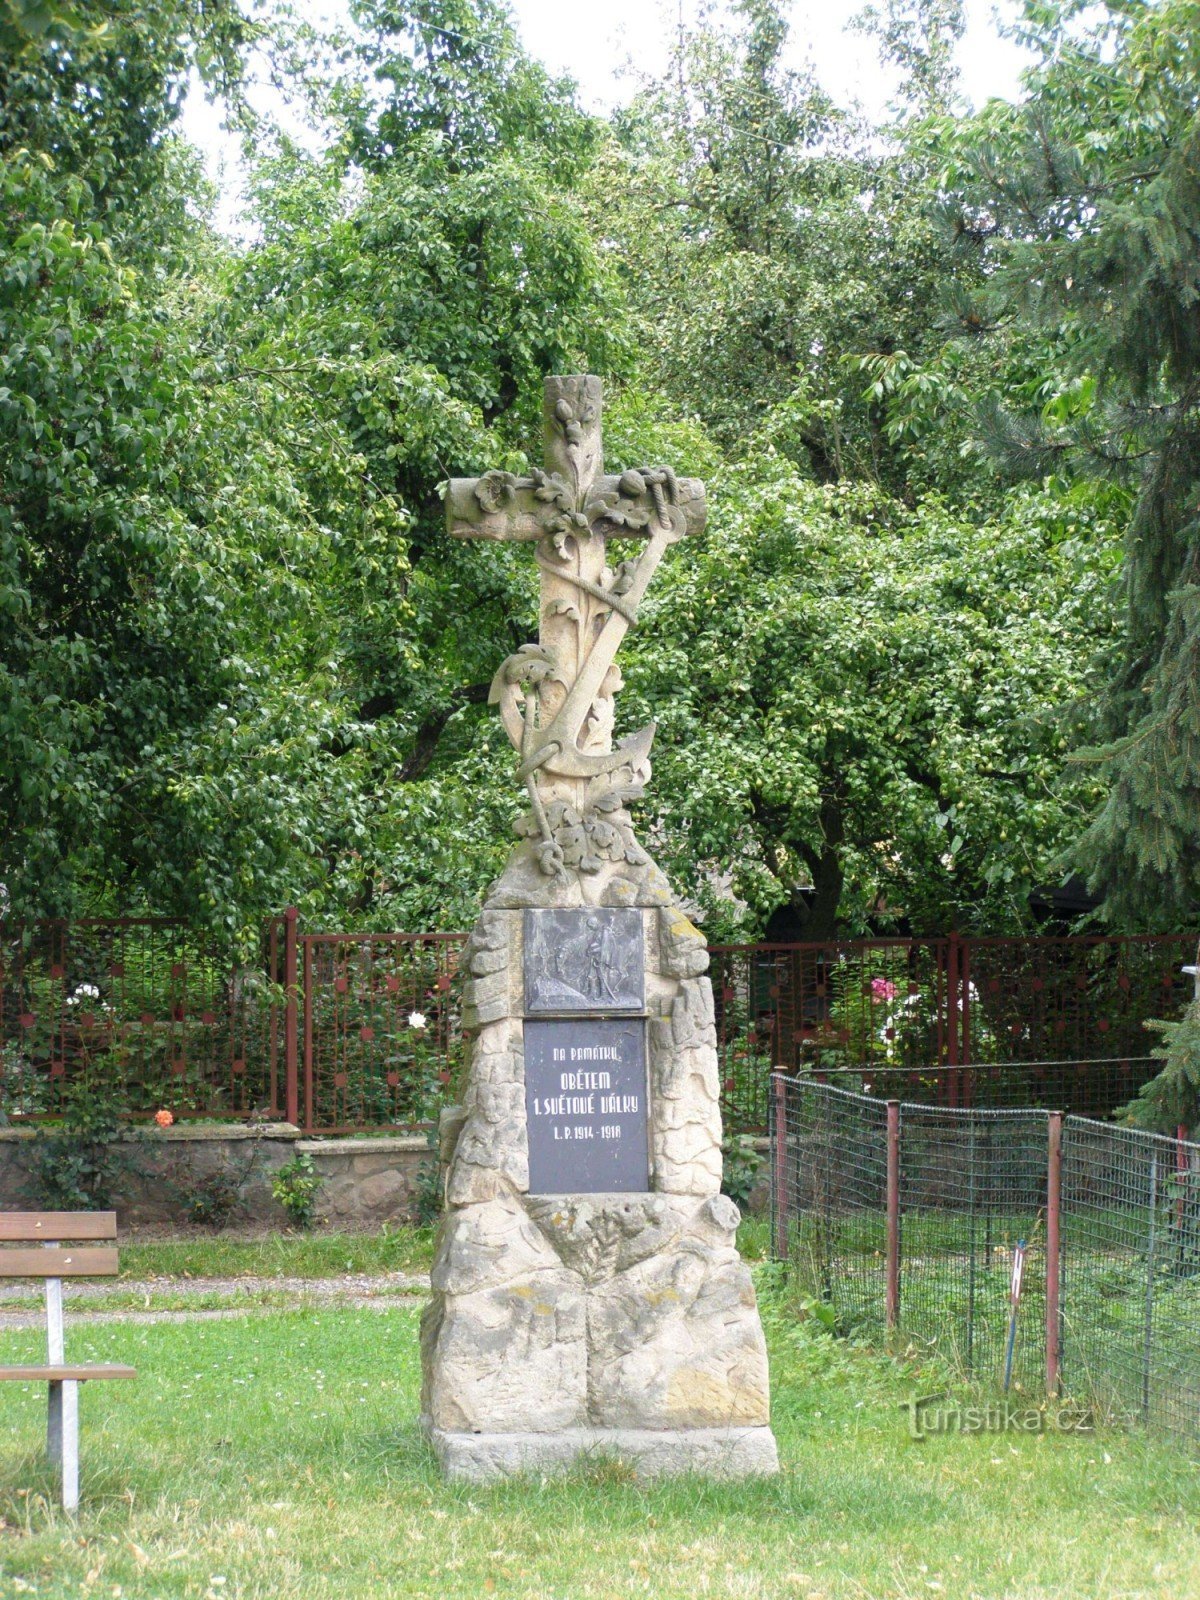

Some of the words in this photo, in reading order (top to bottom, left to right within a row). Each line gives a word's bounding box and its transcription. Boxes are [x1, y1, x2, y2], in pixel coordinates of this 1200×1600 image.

[553, 1048, 566, 1061] NA
[570, 1045, 617, 1061] PAMÁTKU
[560, 1067, 611, 1090] OBĚTEM
[600, 1092, 638, 1114] VÁLKY
